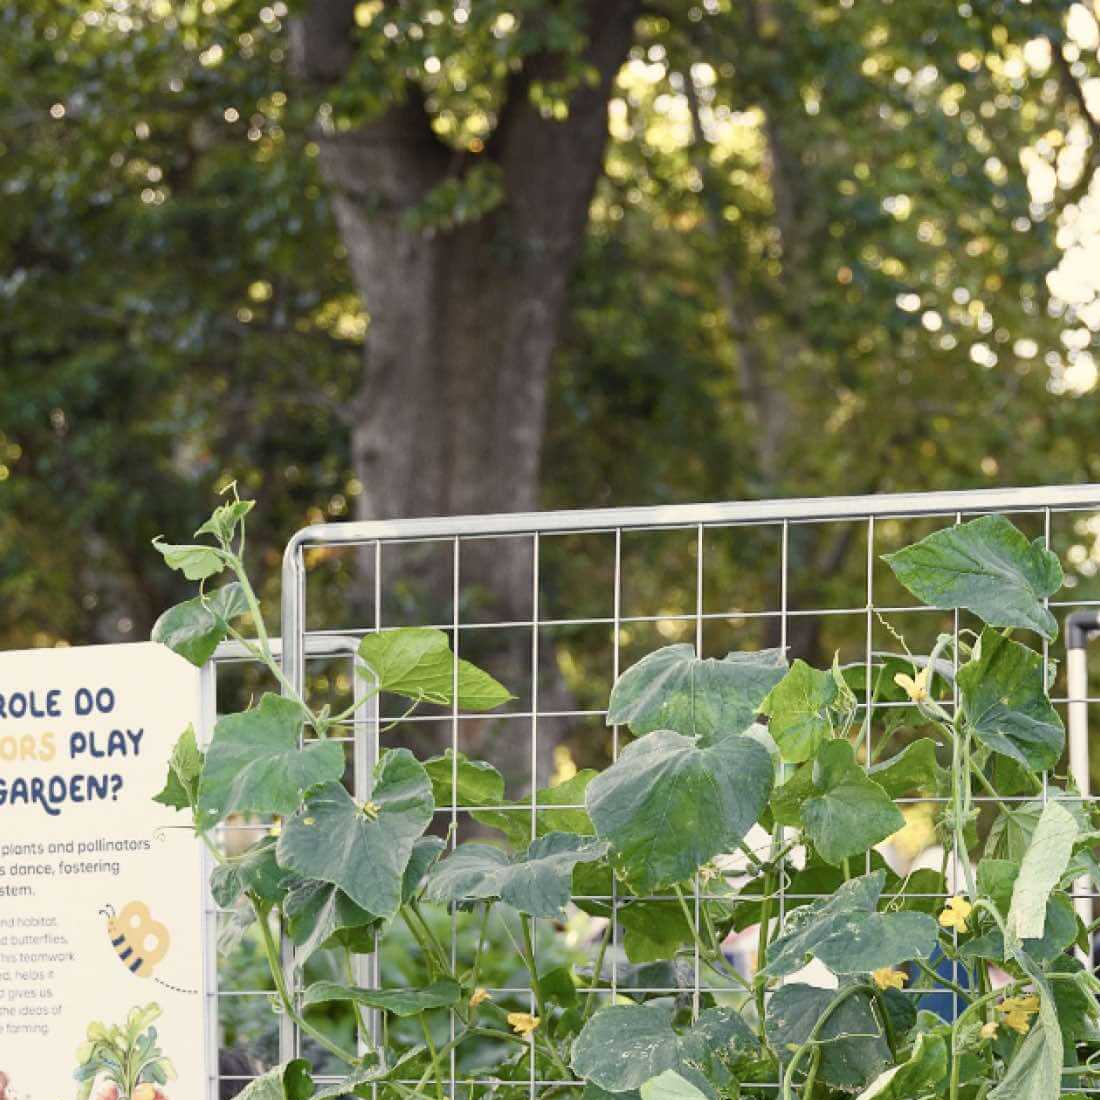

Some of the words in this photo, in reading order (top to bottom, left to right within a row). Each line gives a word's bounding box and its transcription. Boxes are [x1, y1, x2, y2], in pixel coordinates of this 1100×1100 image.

[74, 687, 115, 716] DO
[69, 728, 144, 759] PLAY
[1, 842, 44, 856] plants
[48, 840, 74, 854] and
[78, 837, 151, 855] pollinators
[9, 863, 55, 876] dance,
[59, 859, 120, 875] fostering
